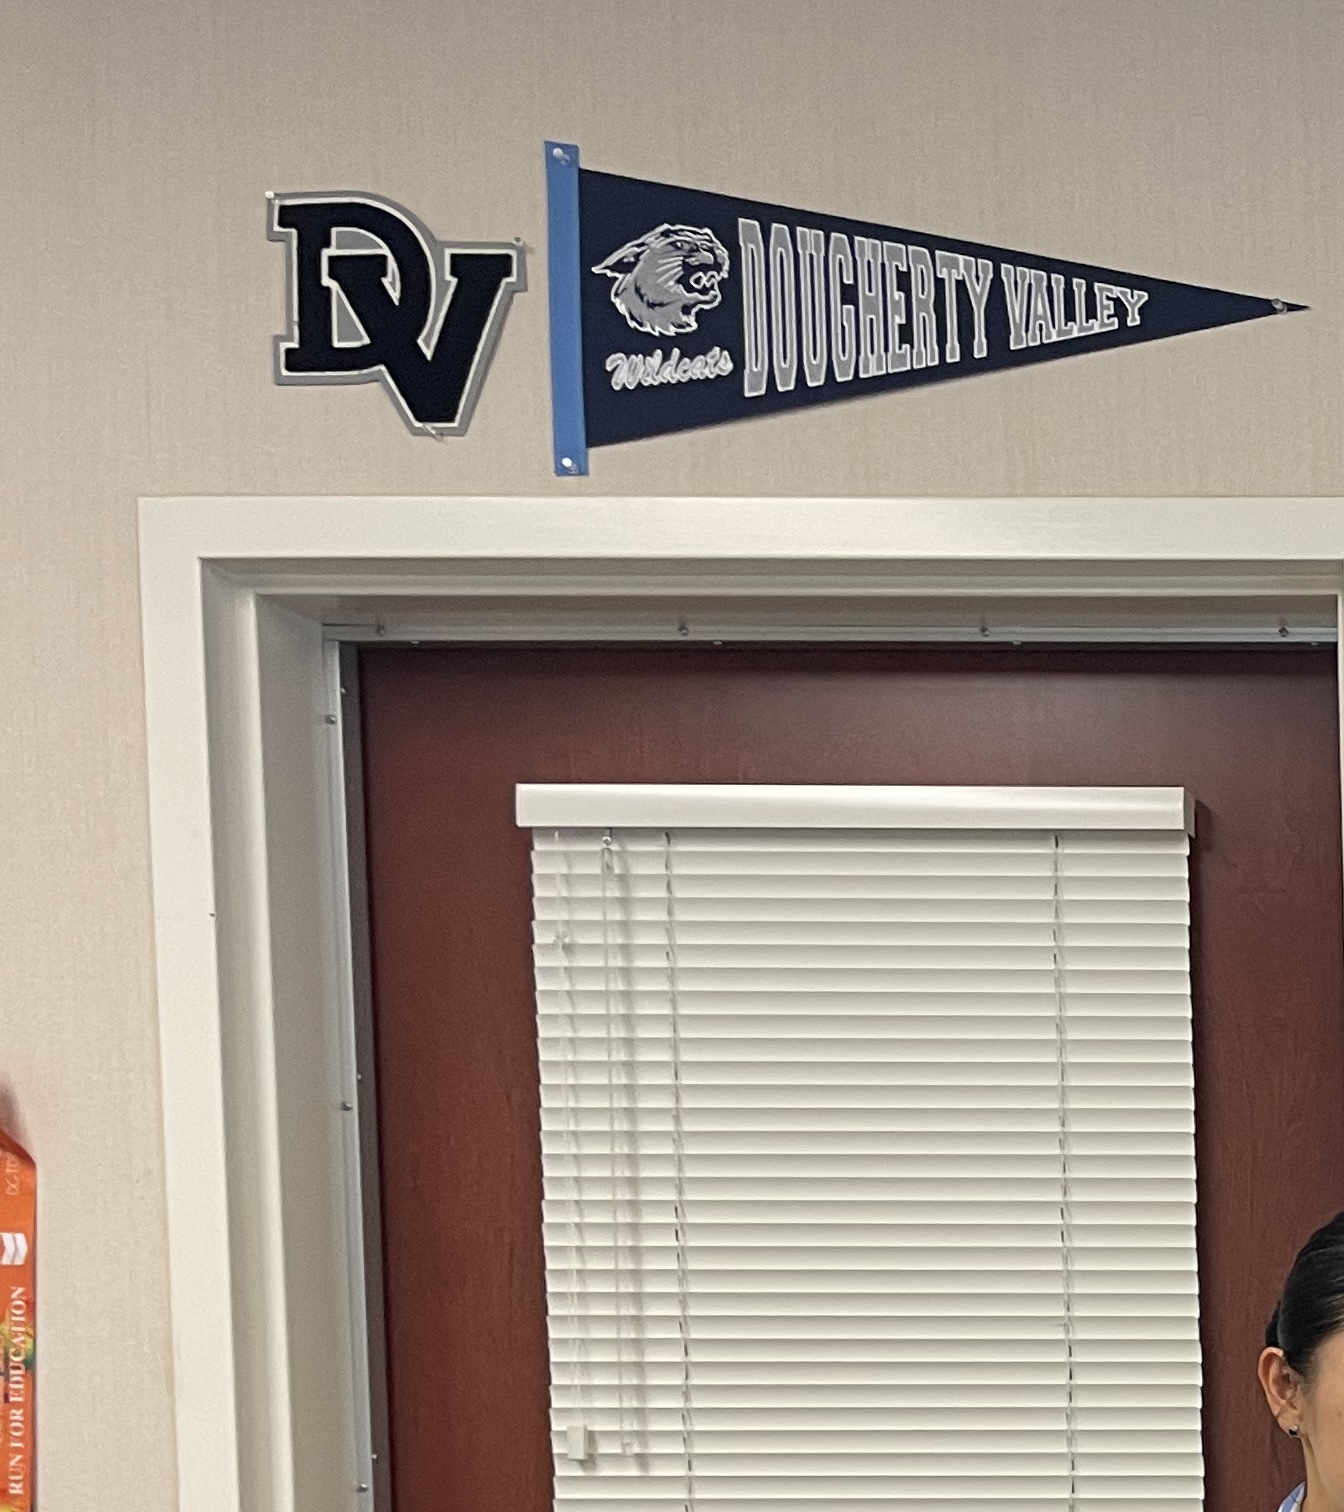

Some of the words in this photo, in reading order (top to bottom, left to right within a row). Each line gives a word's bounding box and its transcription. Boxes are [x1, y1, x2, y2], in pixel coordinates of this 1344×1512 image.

[268, 191, 528, 434] DV
[738, 216, 993, 398] DOUGHERTY
[1001, 262, 1149, 352] VALLEY
[606, 348, 734, 391] Wildcats
[9, 1285, 26, 1401] EDUCATION
[8, 1402, 24, 1450] FOR
[8, 1455, 24, 1496] RUN
